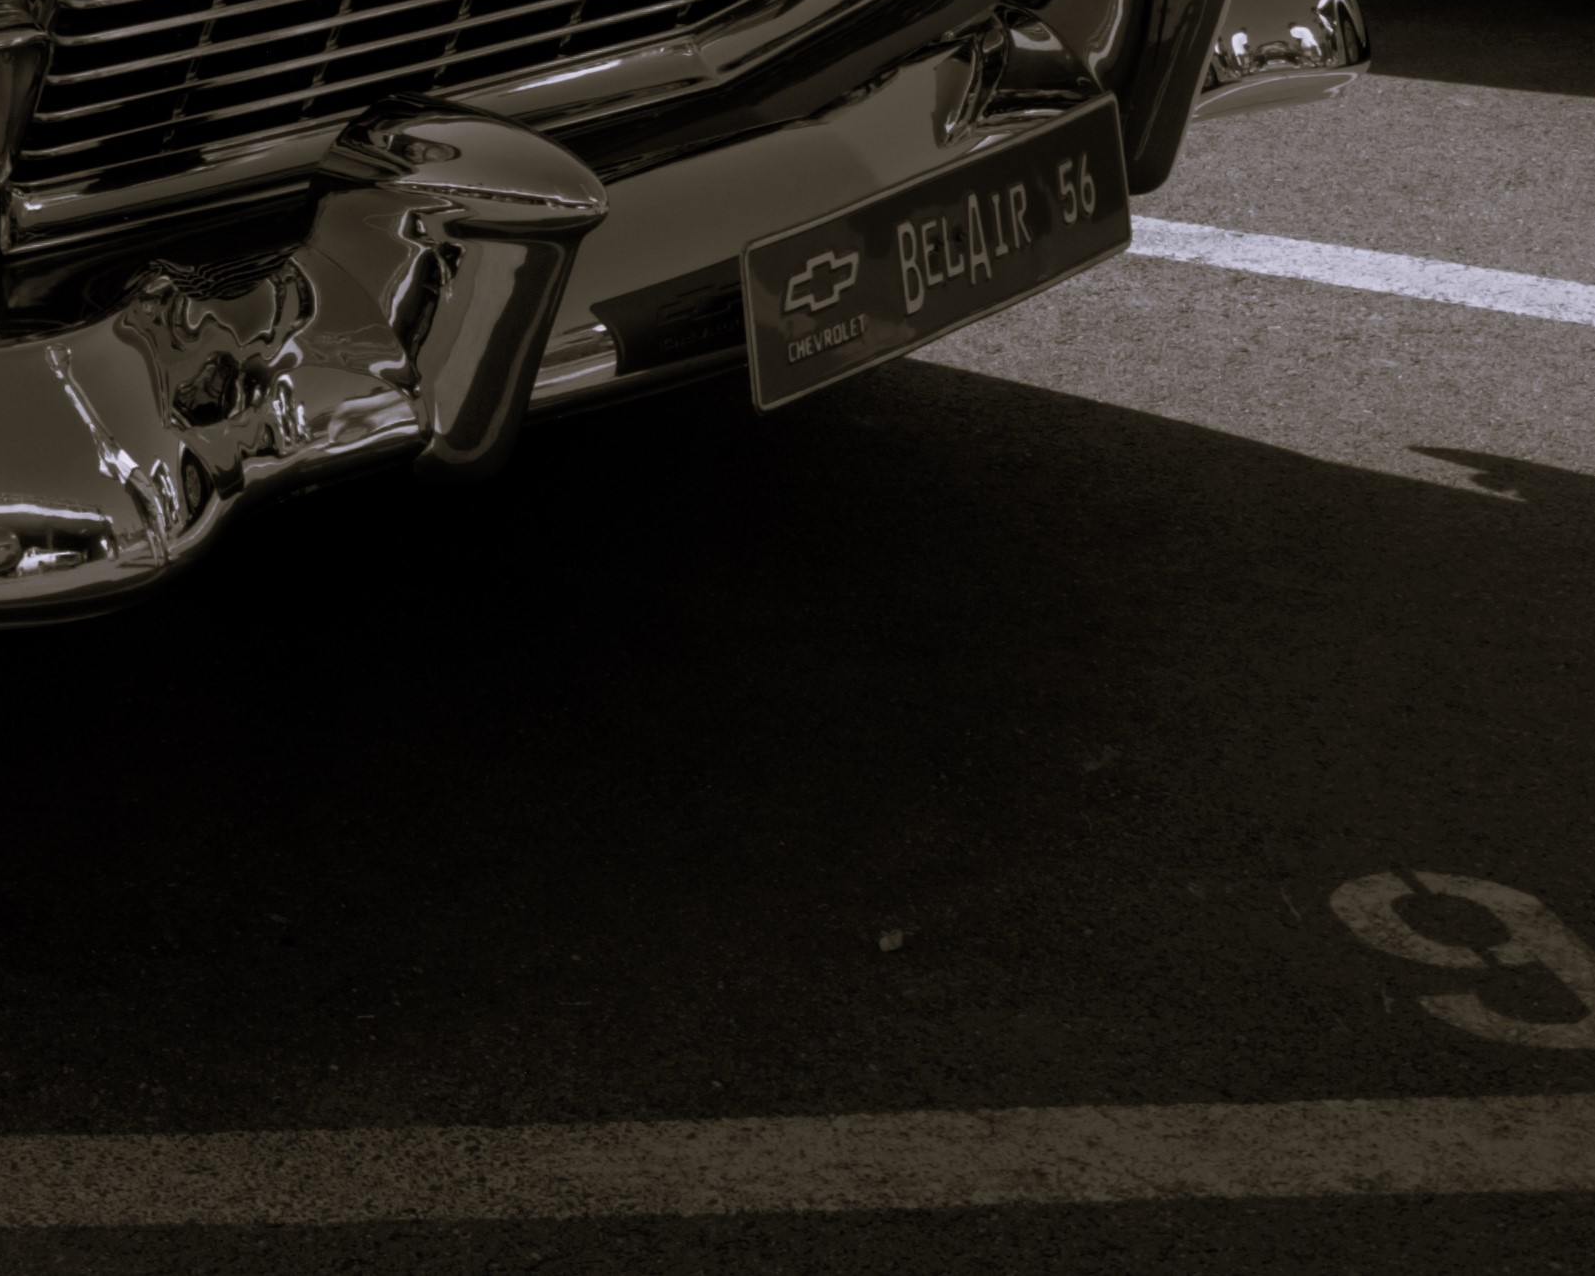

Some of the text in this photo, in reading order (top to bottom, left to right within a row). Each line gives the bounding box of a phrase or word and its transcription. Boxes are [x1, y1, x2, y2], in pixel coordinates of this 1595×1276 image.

[1057, 151, 1097, 226] 56
[787, 312, 867, 364] CHEVROLET
[1330, 869, 1595, 1050] 9
